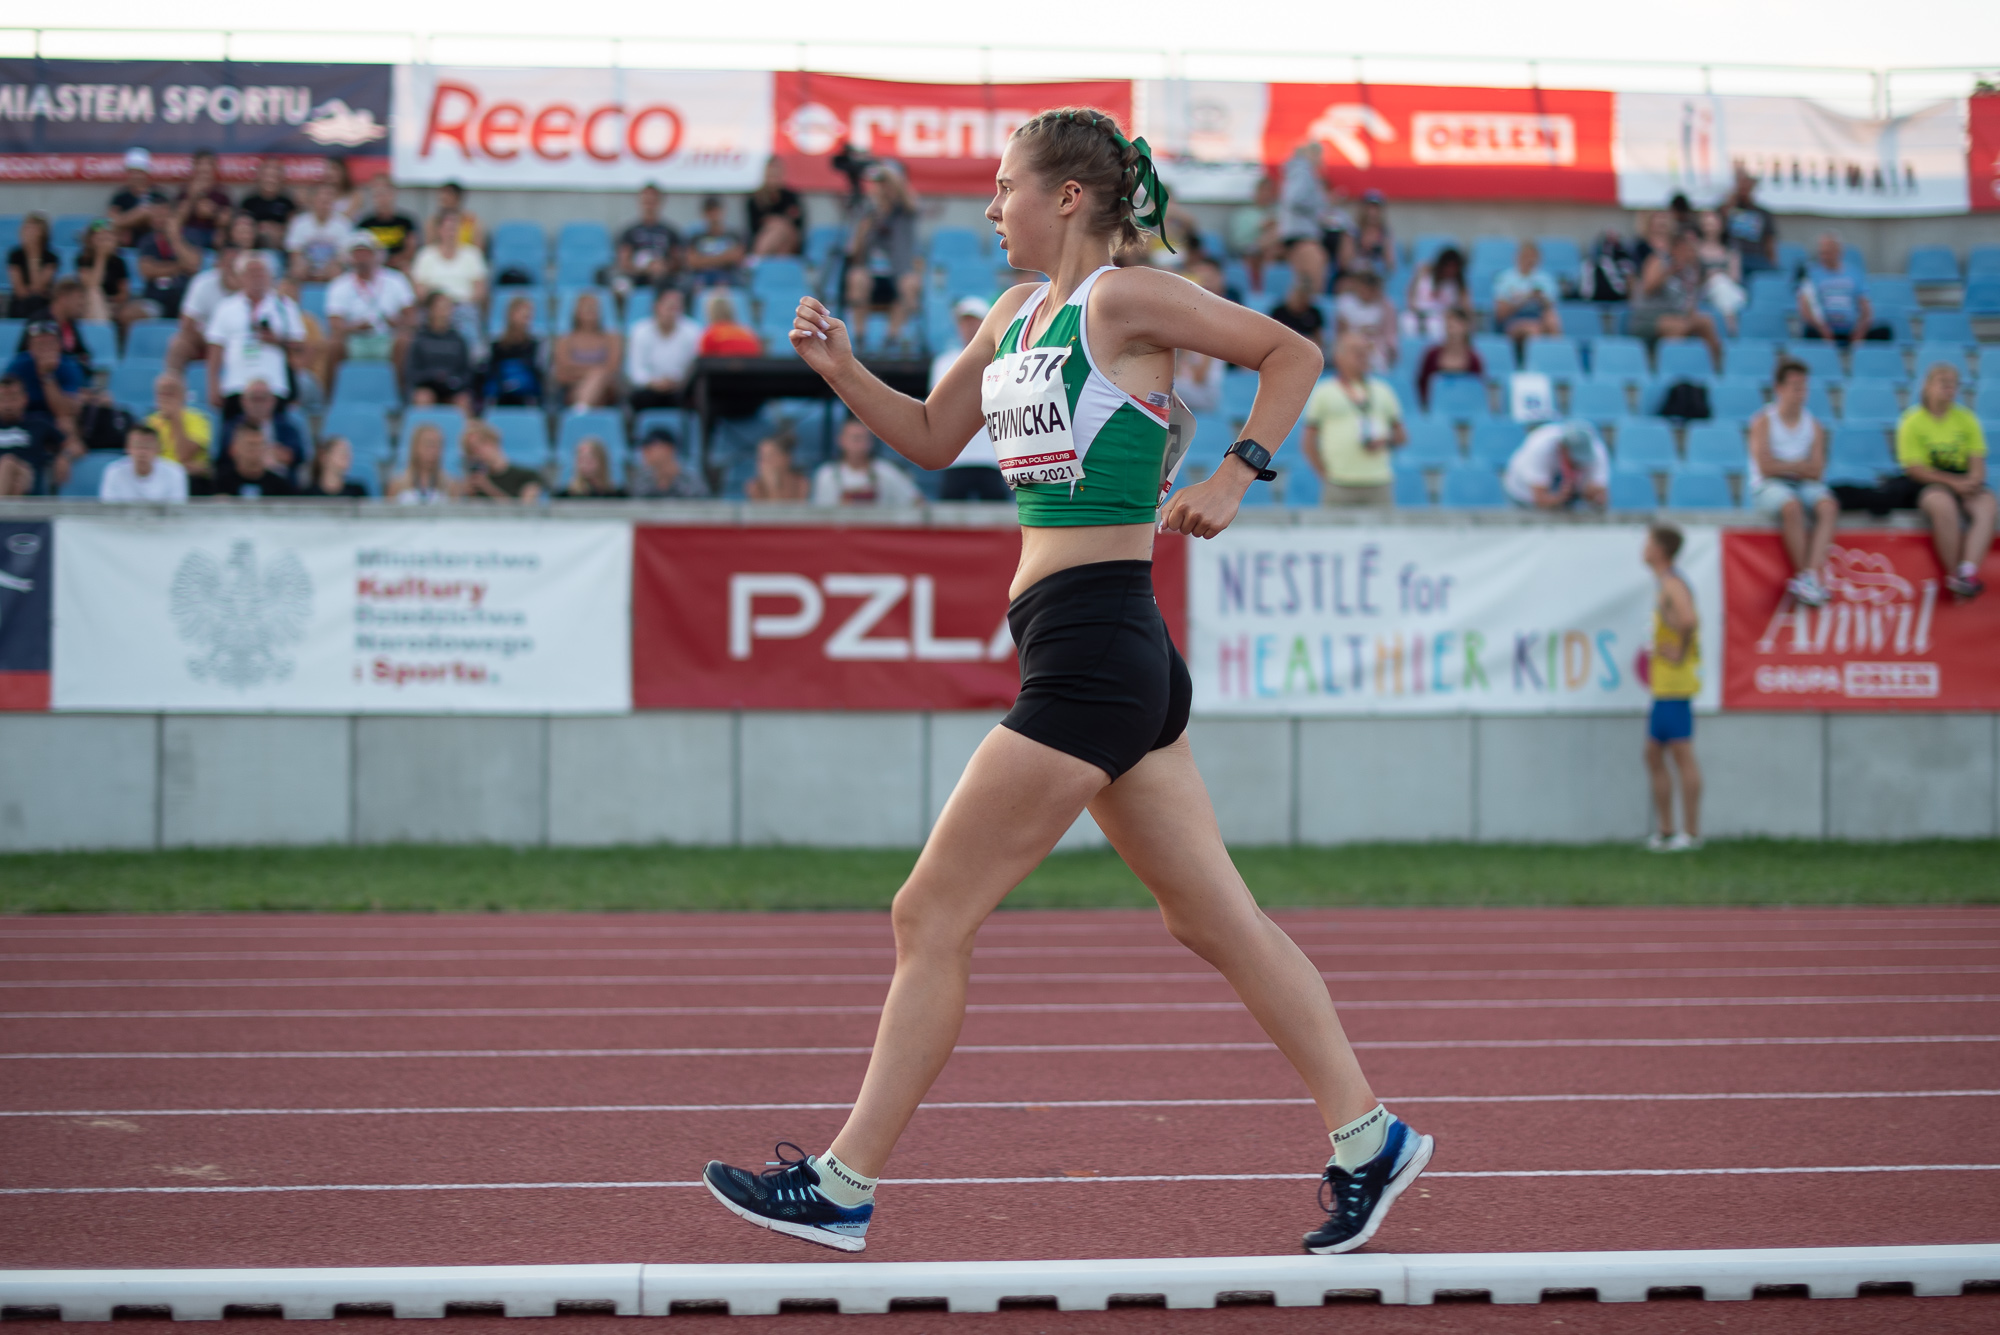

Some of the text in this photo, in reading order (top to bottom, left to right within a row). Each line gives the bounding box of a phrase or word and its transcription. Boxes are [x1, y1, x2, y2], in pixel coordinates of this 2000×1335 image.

[163, 85, 312, 125] SPORTU
[418, 79, 685, 163] Reeco
[1426, 124, 1561, 151] ORLEN
[985, 402, 1066, 442] REWNICKA
[1006, 466, 1074, 482] WEK 2021
[1029, 456, 1055, 464] POLSKI
[356, 550, 540, 569] Ministerstwo
[356, 576, 487, 607] Kultury
[1399, 564, 1454, 614] for
[1756, 578, 1938, 655] Anwil
[355, 633, 535, 657] Narodowego
[1218, 631, 1622, 698] HEALTHIER KIDS
[1332, 1108, 1384, 1144] Runner
[826, 1156, 873, 1192] Runner
